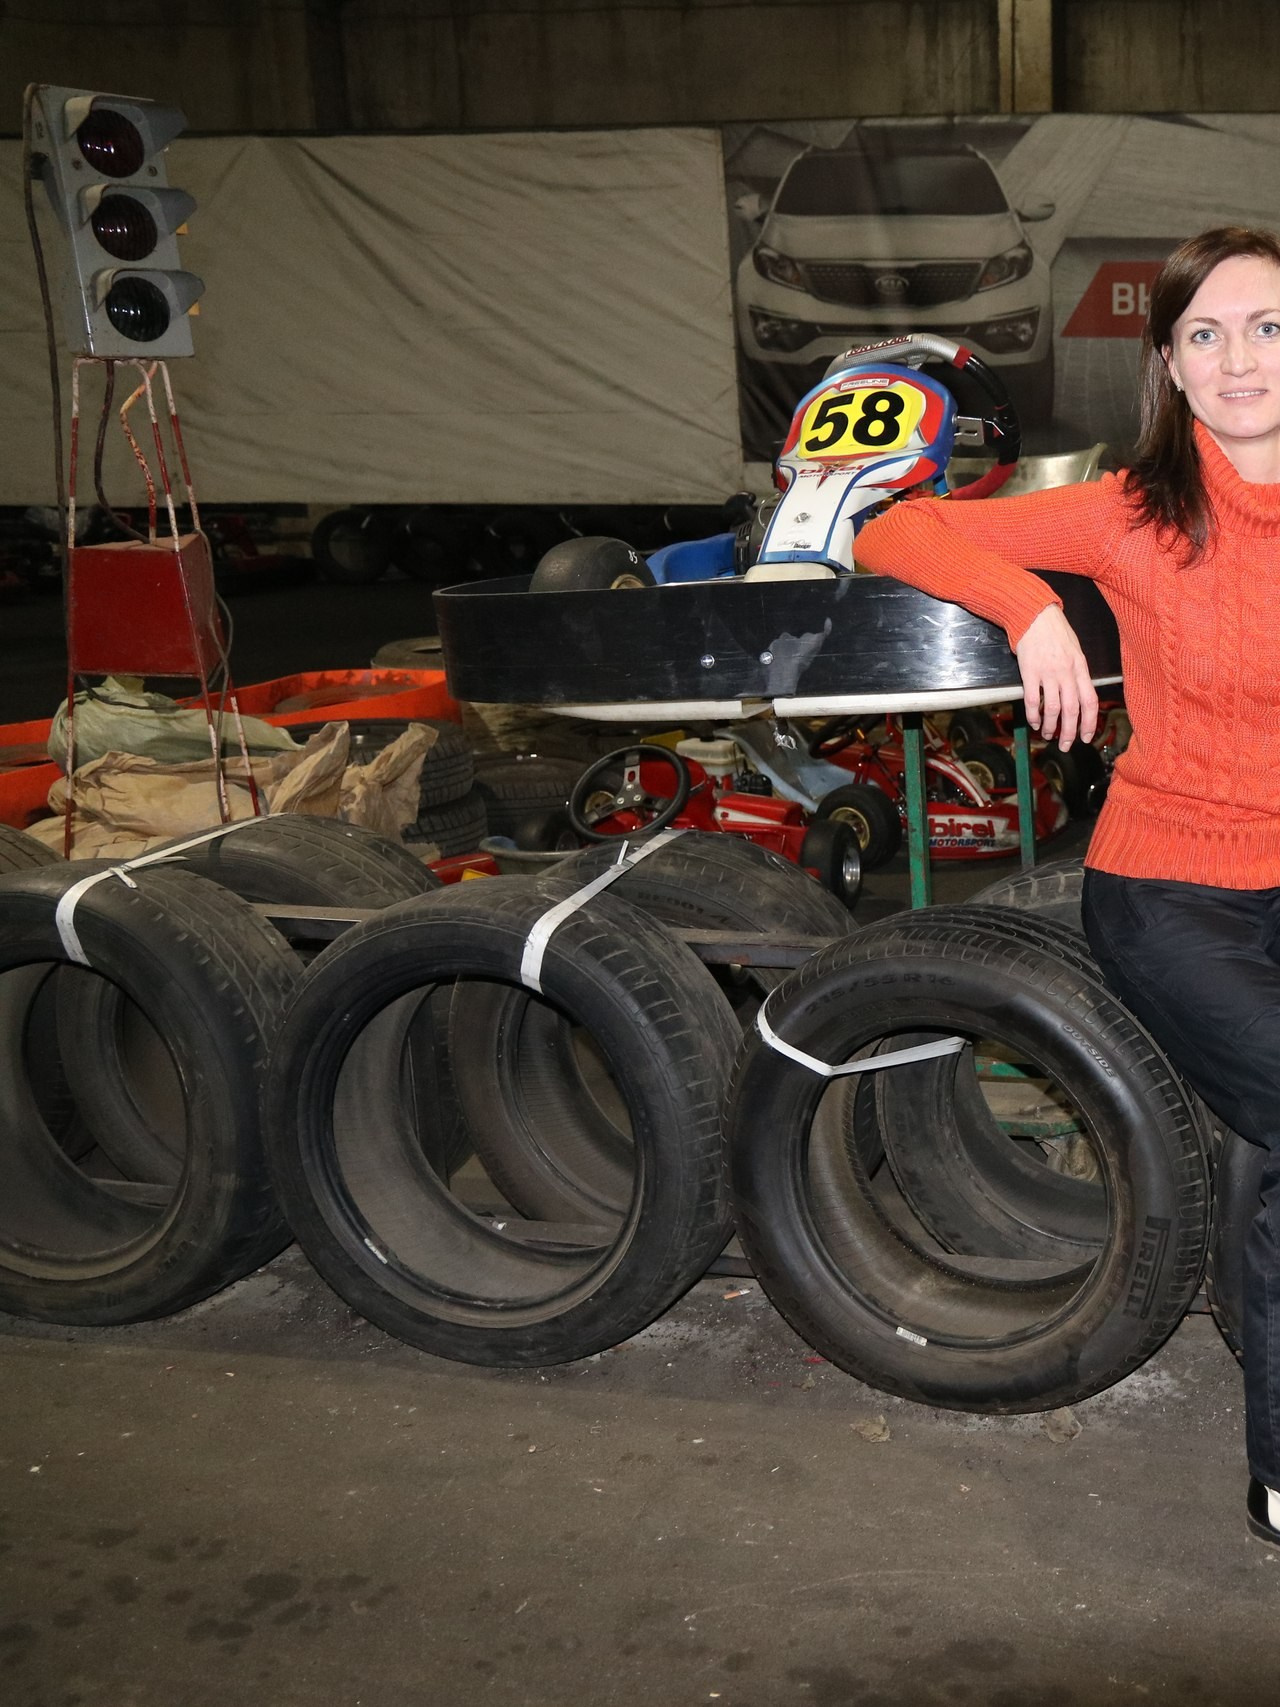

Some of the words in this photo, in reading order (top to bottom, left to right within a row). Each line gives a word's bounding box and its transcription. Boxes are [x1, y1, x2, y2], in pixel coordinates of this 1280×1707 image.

[805, 391, 905, 452] 58
[927, 818, 996, 838] birel
[1063, 1024, 1115, 1078] OUTSIDE
[1121, 1215, 1172, 1318] PIRELLI
